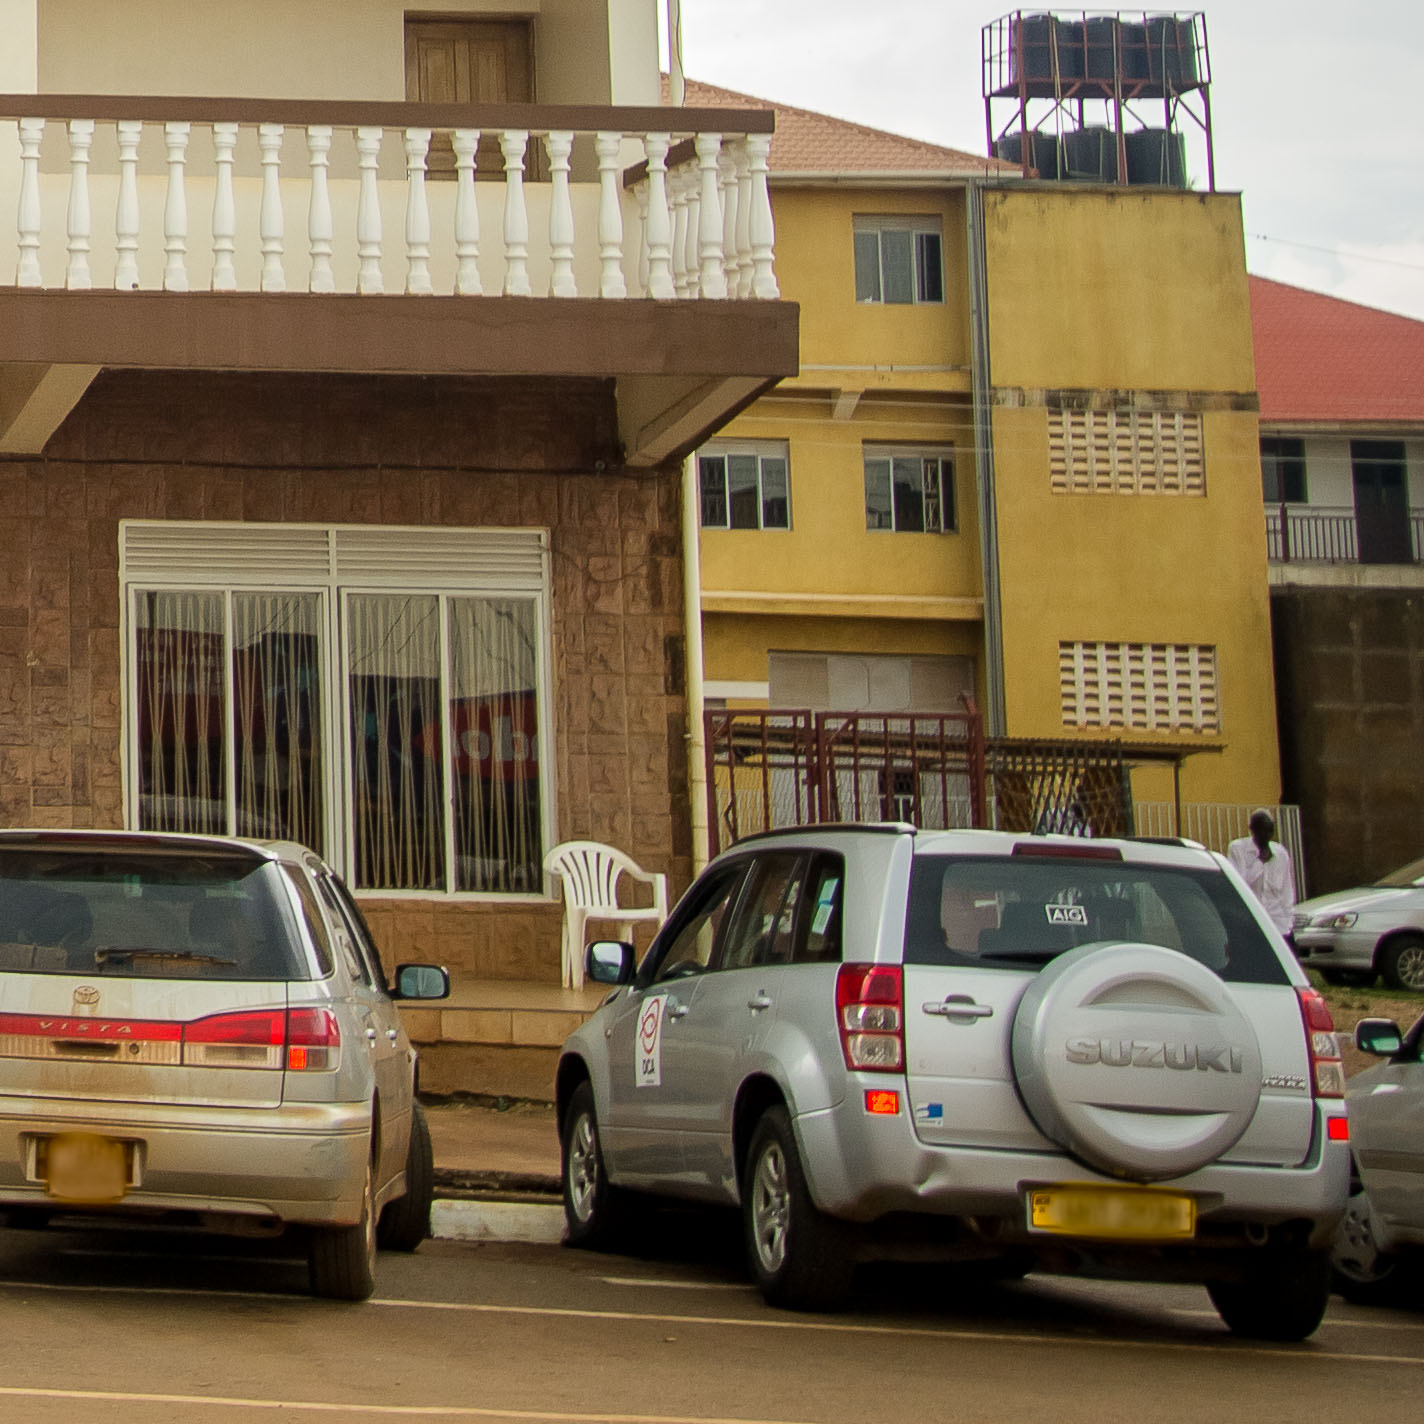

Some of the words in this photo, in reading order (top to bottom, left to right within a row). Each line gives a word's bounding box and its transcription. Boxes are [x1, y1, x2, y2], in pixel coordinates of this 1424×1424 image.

[1052, 907, 1082, 922] AIG
[39, 1021, 132, 1034] VISTA
[1065, 1038, 1243, 1074] SUZUKI
